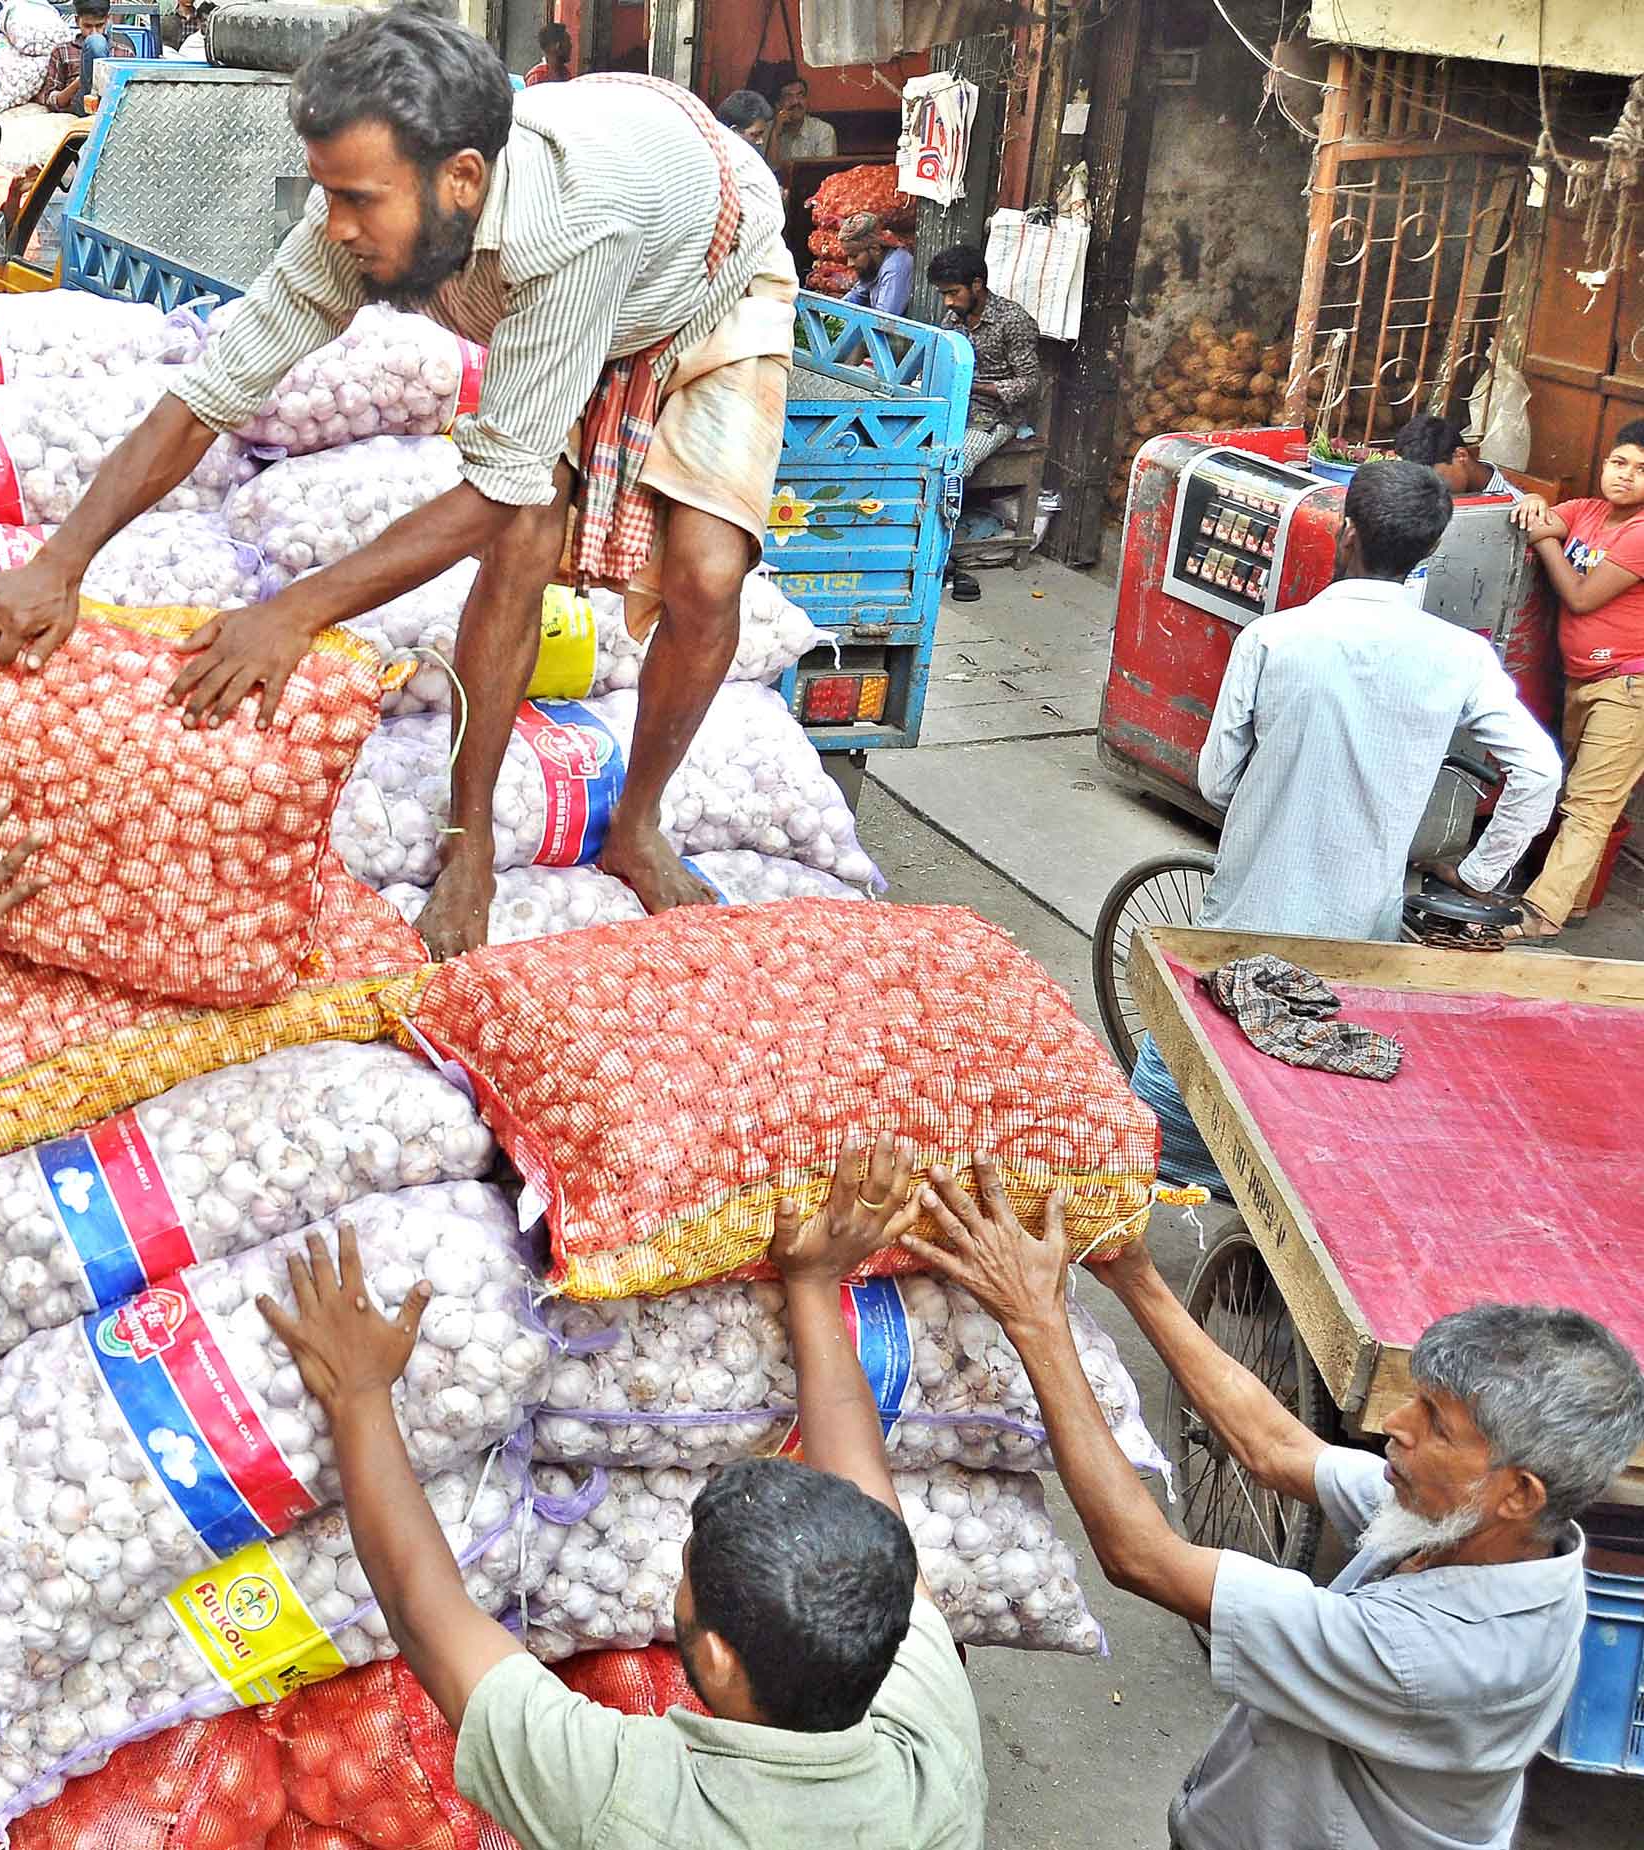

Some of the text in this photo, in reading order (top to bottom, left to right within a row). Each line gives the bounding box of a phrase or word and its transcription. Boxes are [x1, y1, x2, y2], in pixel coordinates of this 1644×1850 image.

[190, 1338, 218, 1381] PRODUCE
[213, 1380, 225, 1393] OF
[220, 1393, 242, 1426] CHINA
[195, 1582, 252, 1659] FULKOLI
